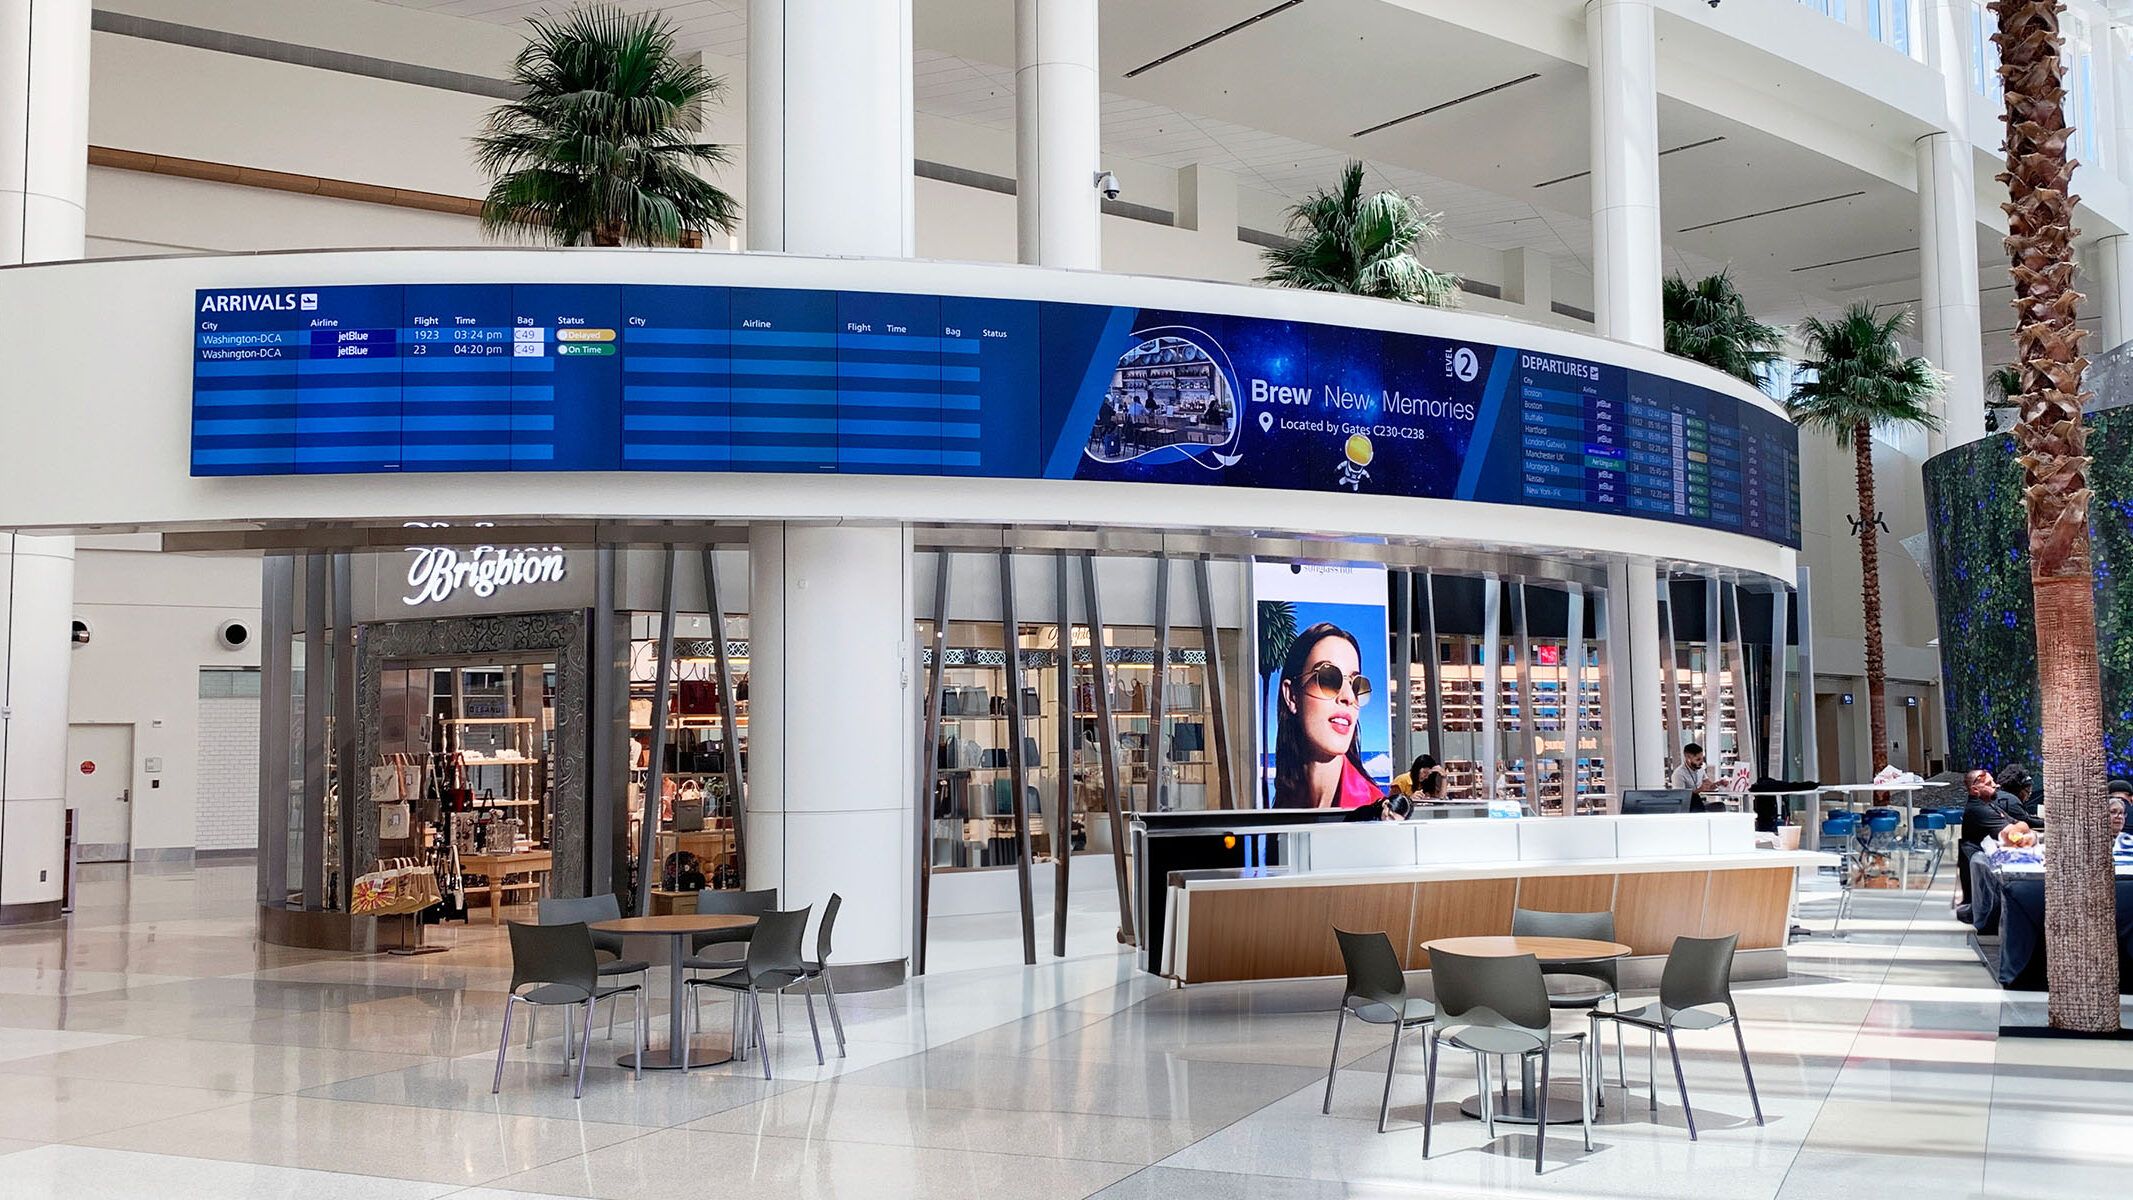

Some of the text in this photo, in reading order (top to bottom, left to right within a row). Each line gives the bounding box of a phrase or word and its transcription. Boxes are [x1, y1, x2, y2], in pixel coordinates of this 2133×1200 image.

[201, 294, 296, 312] ARRIVALS
[201, 316, 585, 331] City Airline Flight Time Bag Status
[629, 316, 1008, 338] City Airline Flight Time Bag Status
[202, 334, 282, 345] Washington-DCA
[337, 331, 369, 343] jetBlue
[414, 331, 440, 340] 1923
[454, 331, 484, 340] 03:24
[486, 333, 502, 342] pm
[567, 331, 601, 341] Delayed
[202, 348, 282, 359] Washington-DCA
[337, 346, 369, 358] jetBlue
[413, 345, 427, 354] 23
[454, 345, 484, 354] 04:20
[486, 347, 502, 356] pm
[568, 346, 580, 354] On
[582, 346, 602, 354] Time
[1445, 347, 1472, 377] LEVEL 2
[1522, 355, 1589, 379] DEPARTURES
[1523, 376, 1533, 386] City
[1251, 378, 1475, 421] Brew New Memories
[1523, 388, 1543, 398] Boston
[1524, 400, 1543, 410] Boston
[1524, 412, 1544, 422] Buffalo
[1280, 418, 1425, 440] Located by Gates C230-C238
[1525, 424, 1548, 435] Hartford
[1525, 437, 1567, 449] London Gatwick
[1525, 450, 1556, 461] Manchester
[1556, 452, 1565, 461] UK
[1525, 462, 1550, 473] Montego
[1550, 464, 1560, 474] Bay
[1526, 474, 1545, 483] Nassau
[1526, 486, 1539, 495] New
[403, 547, 566, 605] Brighton
